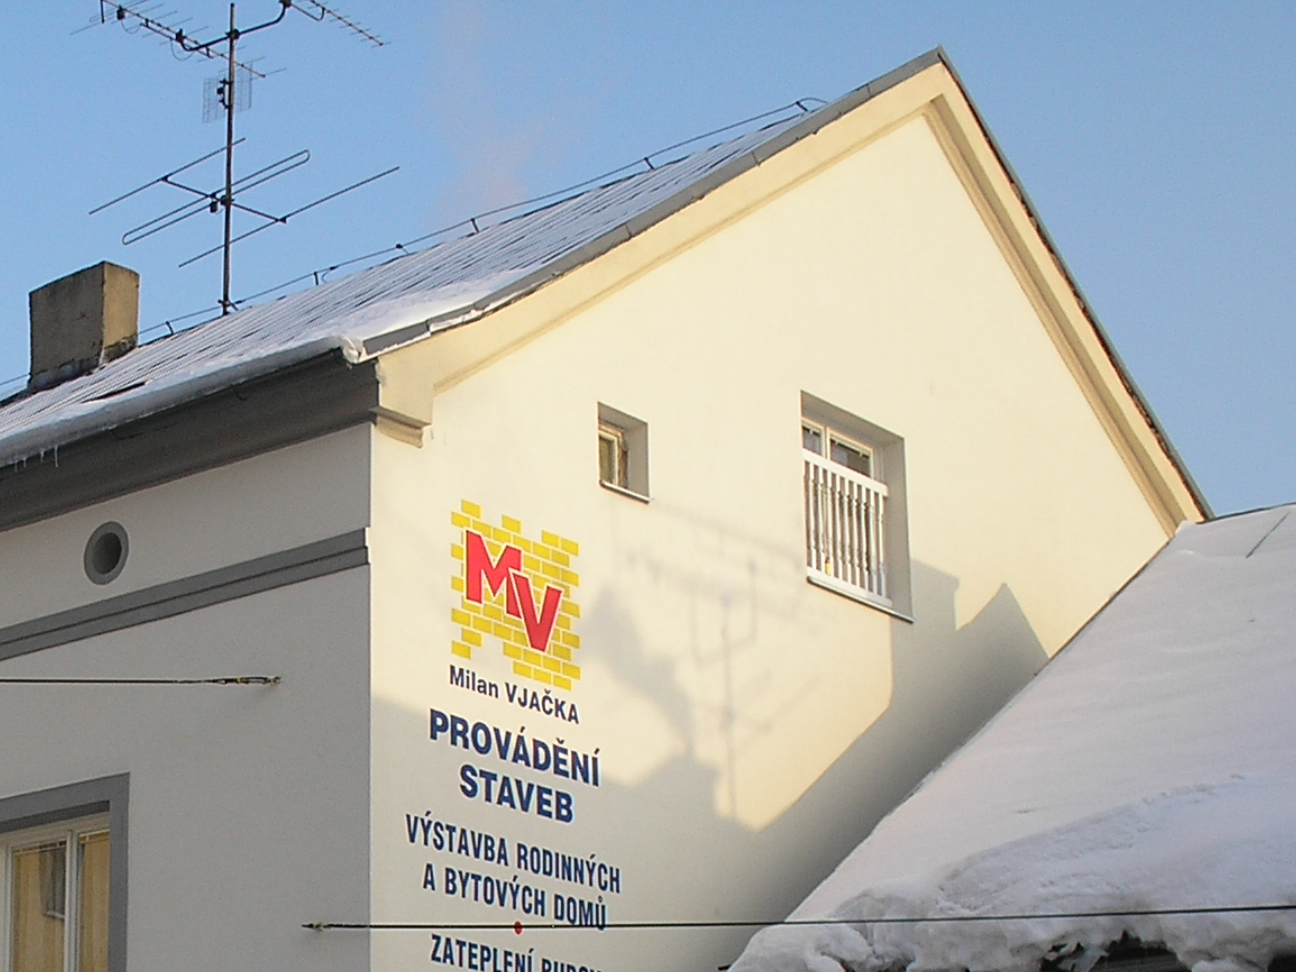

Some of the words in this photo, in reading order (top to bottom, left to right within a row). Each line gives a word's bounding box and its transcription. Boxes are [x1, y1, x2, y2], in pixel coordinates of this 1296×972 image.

[466, 530, 562, 653] MV
[450, 665, 499, 699] Milan
[505, 683, 580, 725] VJAČKA
[430, 709, 599, 788] PROVÁDĚNÍ
[460, 765, 573, 824] STAVEB
[406, 811, 509, 867] VÝSTAVBA
[517, 843, 621, 894] RODINNÝCH
[423, 863, 436, 892] A
[445, 868, 546, 918] BYTOVÝCH
[554, 894, 606, 930] DOMŮ
